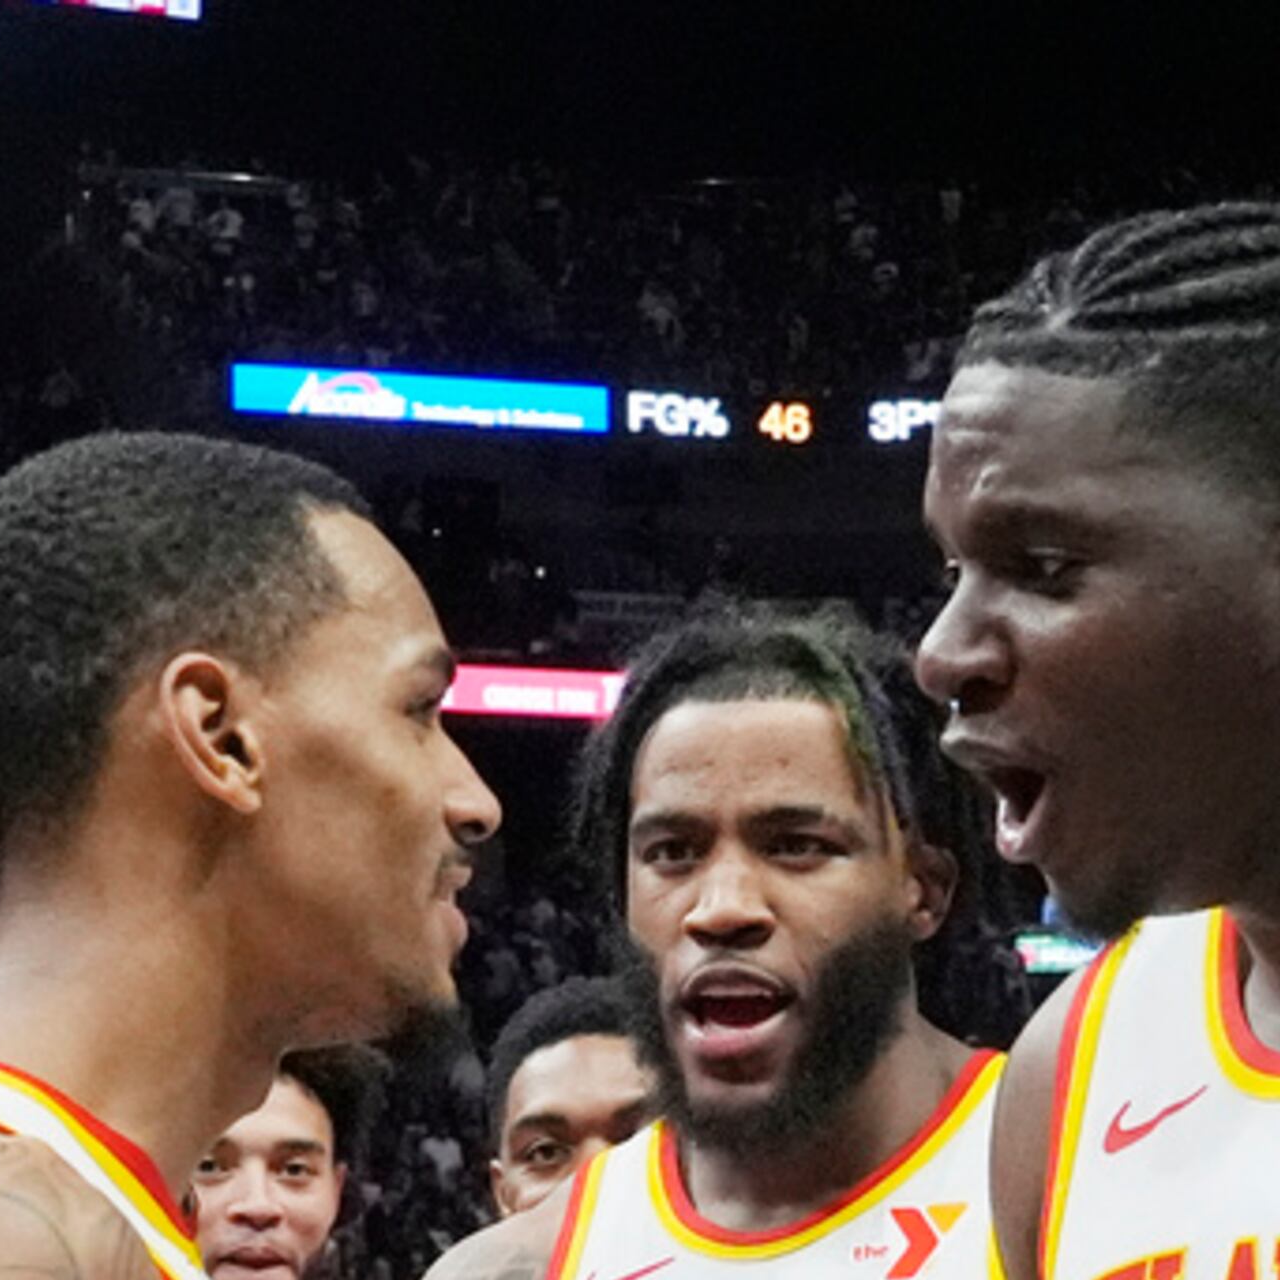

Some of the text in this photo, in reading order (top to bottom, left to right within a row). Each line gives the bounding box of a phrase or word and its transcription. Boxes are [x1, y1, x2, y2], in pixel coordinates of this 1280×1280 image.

[627, 391, 812, 443] FG% 46
[869, 399, 942, 442] 3P
